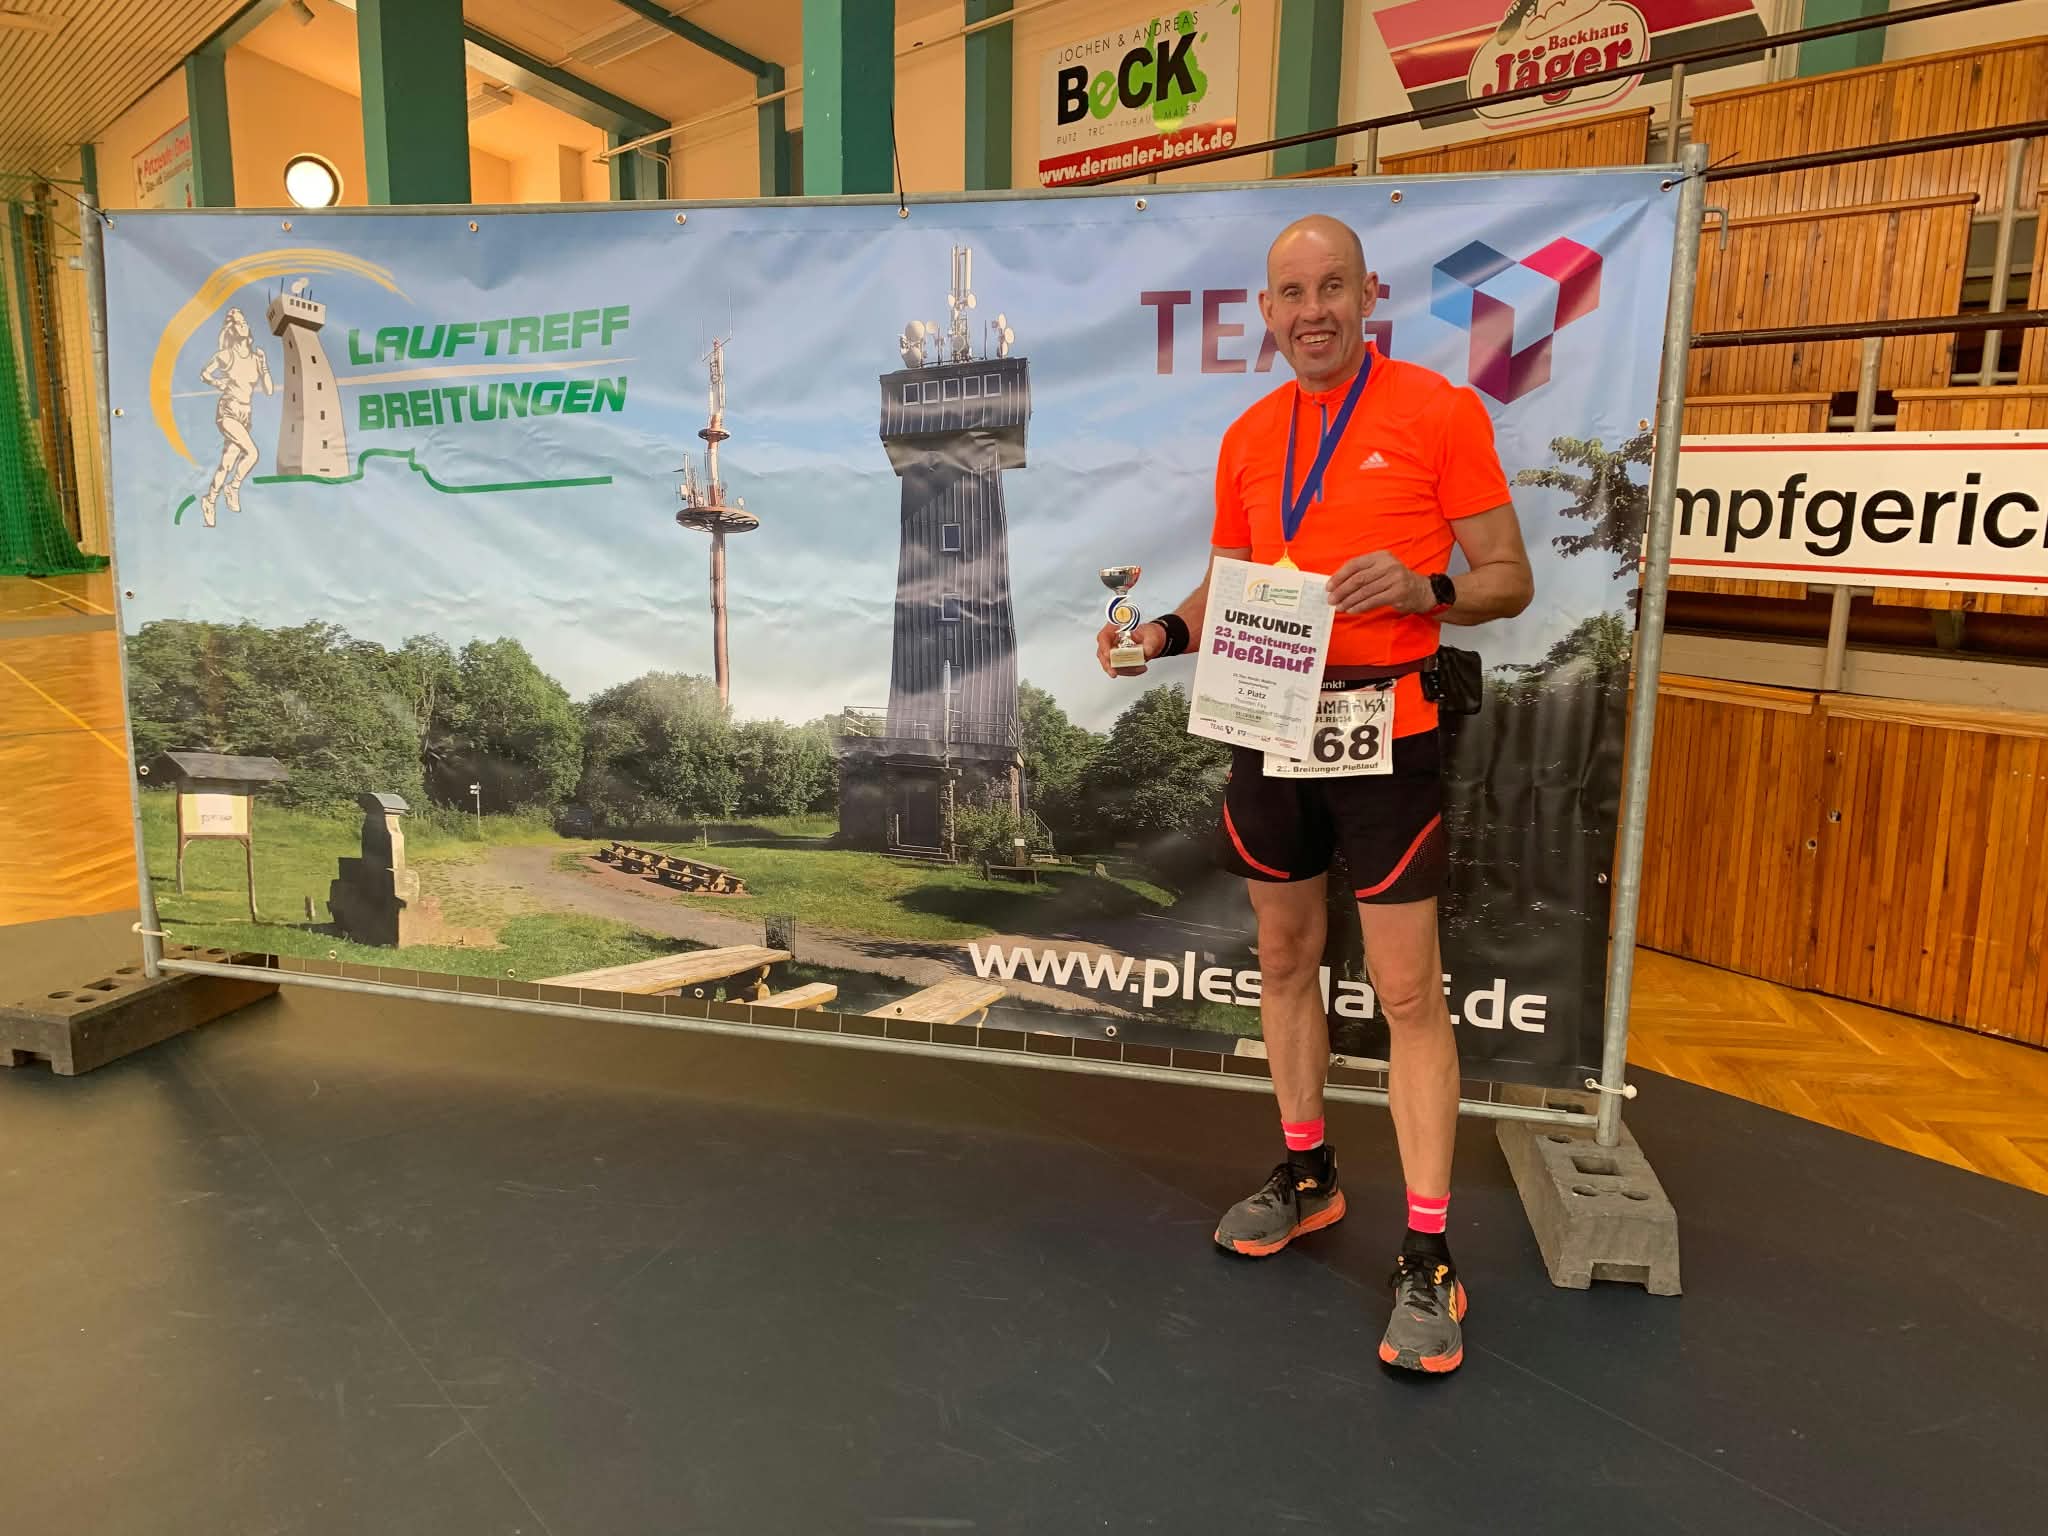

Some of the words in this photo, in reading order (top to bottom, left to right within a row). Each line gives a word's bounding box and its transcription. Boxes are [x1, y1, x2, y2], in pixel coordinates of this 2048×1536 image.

[1058, 38, 1110, 65] JOCHEN
[1118, 33, 1126, 47] &
[1133, 11, 1199, 43] ANDREAS
[1548, 22, 1629, 51] Backhaus
[1482, 38, 1633, 105] Jäger
[1163, 104, 1198, 120] MALER
[1039, 127, 1234, 186] www.dermaler-beck.de
[348, 305, 630, 366] LAUFTREFF
[358, 376, 628, 432] BREITUNGEN
[1674, 472, 2048, 557] mpfgeric
[1215, 625, 1236, 639] 23.
[1238, 630, 1317, 655] Breitunger
[1224, 609, 1313, 639] URKUNDE
[1212, 638, 1316, 675] Pleßlauf
[1238, 687, 1246, 696] 2.
[1247, 689, 1267, 700] Platz
[1290, 725, 1380, 763] 68
[1293, 765, 1341, 774] Breitunger
[967, 942, 1548, 1034] www.plesla.de
